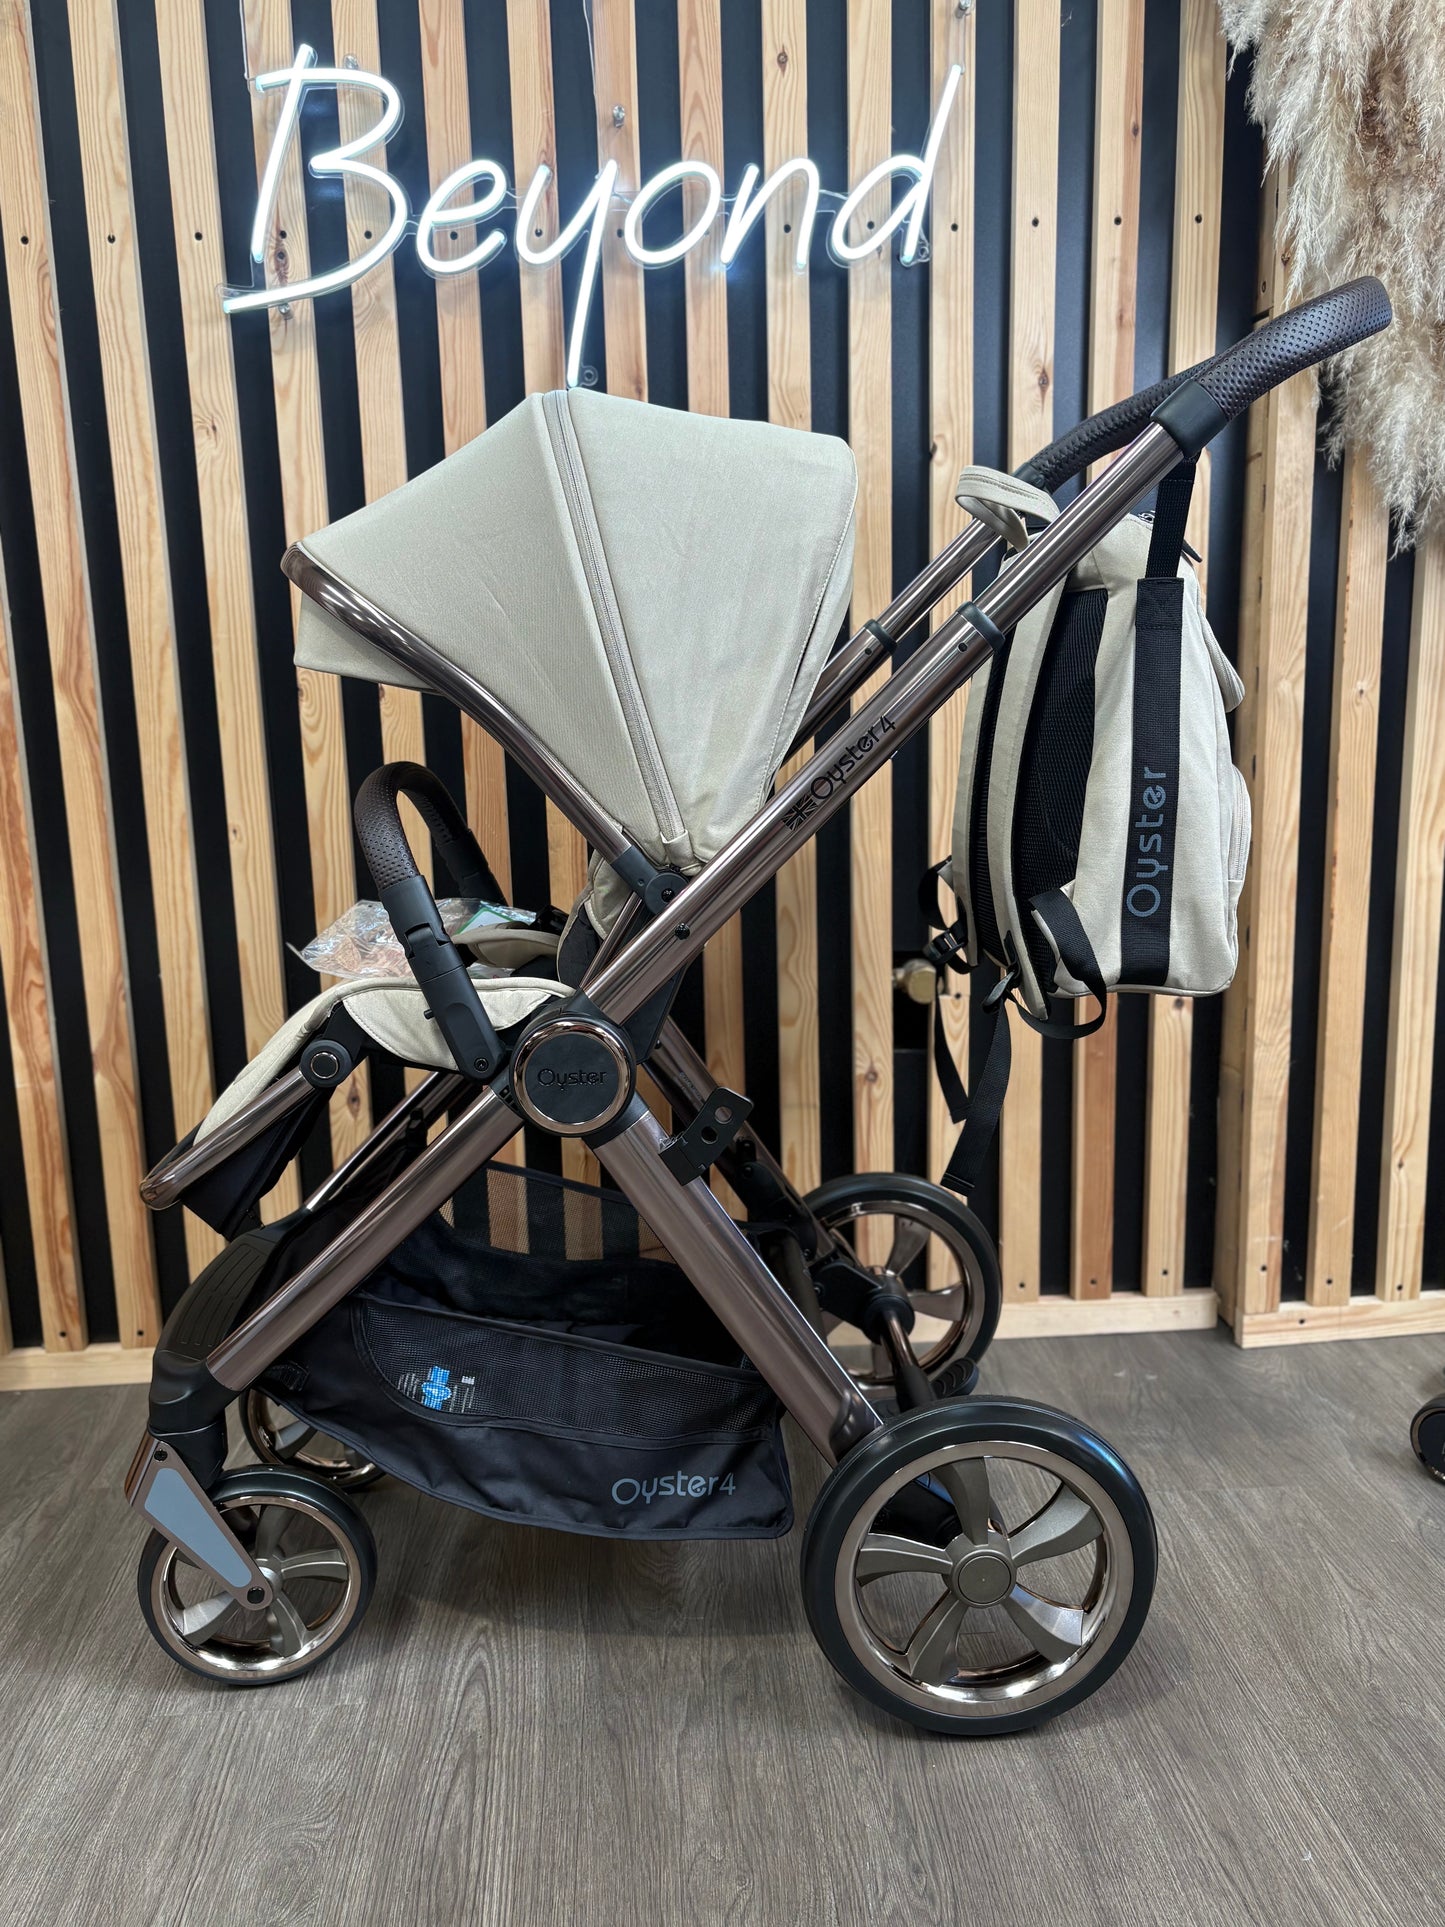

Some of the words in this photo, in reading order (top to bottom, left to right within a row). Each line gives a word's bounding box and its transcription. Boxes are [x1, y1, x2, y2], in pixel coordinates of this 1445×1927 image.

[223, 44, 962, 388] Beyond
[1126, 767, 1169, 918] Oyster
[537, 1068, 607, 1091] Oyster
